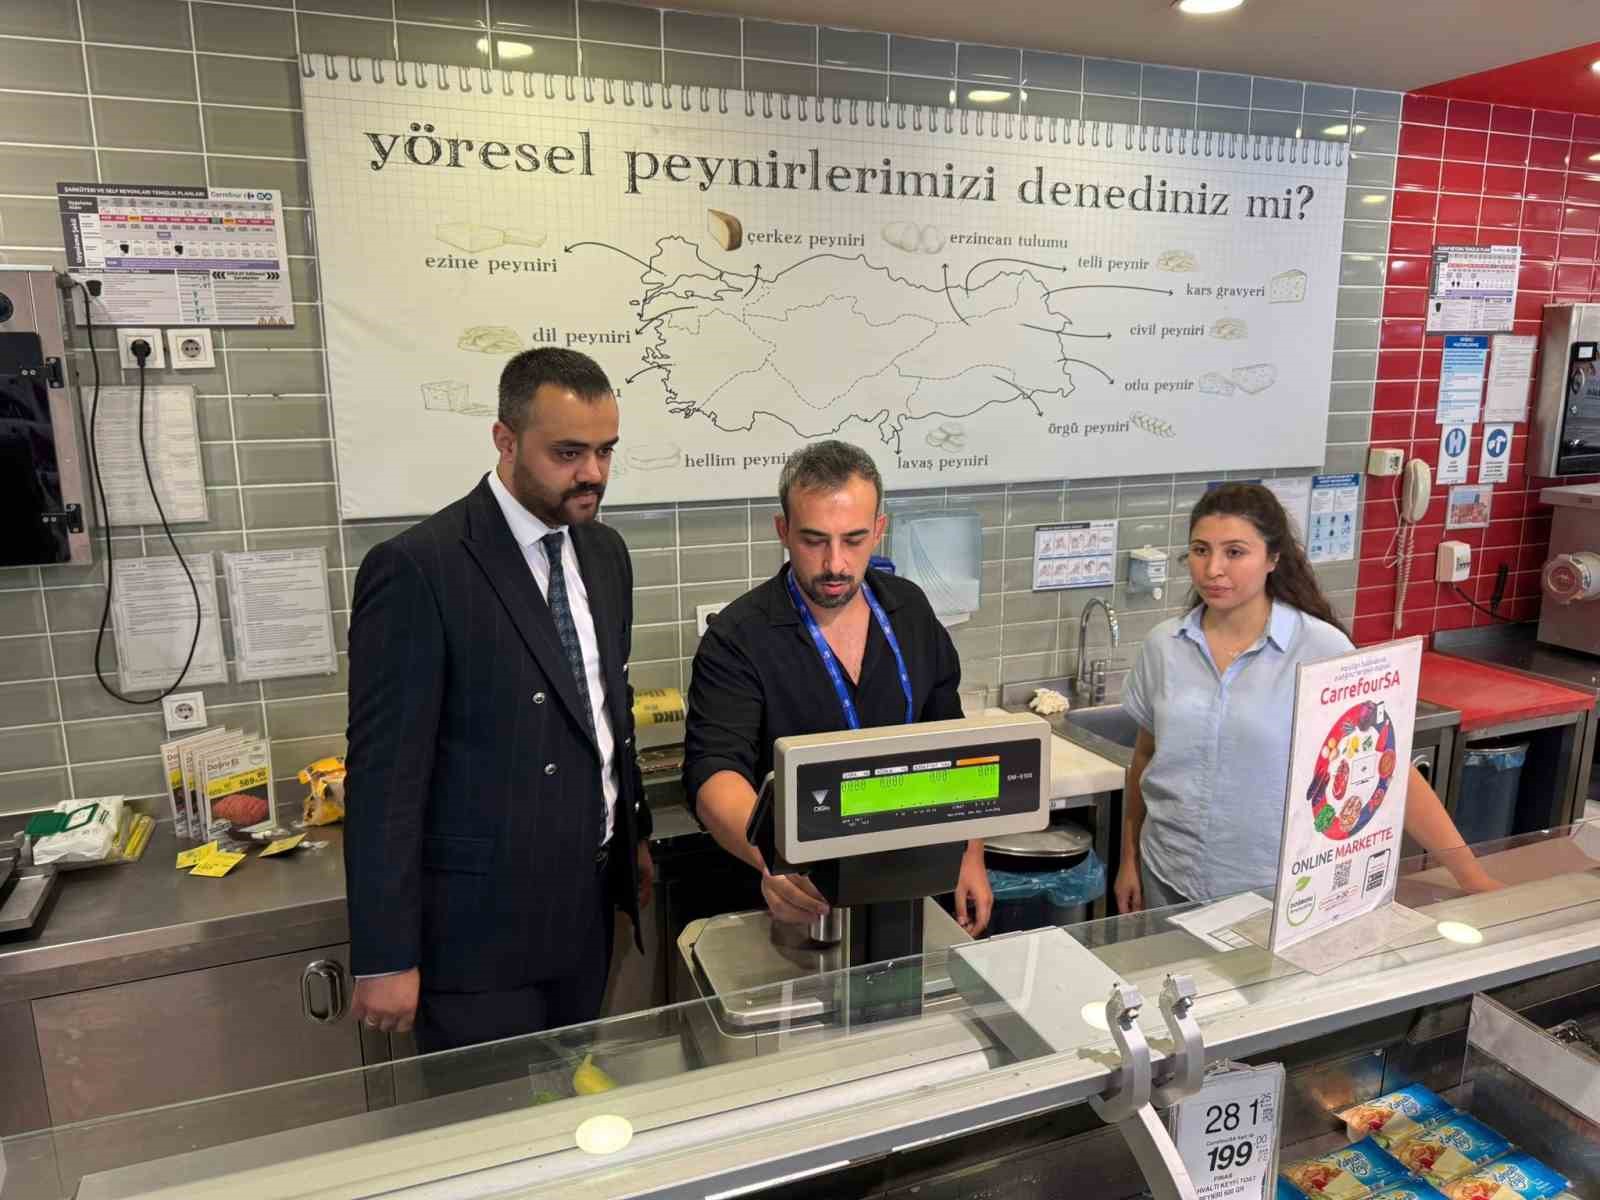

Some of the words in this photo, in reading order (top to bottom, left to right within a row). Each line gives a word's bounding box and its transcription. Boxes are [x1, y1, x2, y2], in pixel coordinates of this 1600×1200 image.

[363, 122, 595, 176] yöresel
[624, 148, 998, 201] peynirlerimizi
[1017, 166, 1230, 216] denediniz
[1246, 184, 1315, 219] mi?
[747, 229, 801, 247] çerkez
[810, 230, 865, 249] peyniri
[950, 229, 1012, 247] erzincan
[1018, 234, 1068, 249] tulumu
[425, 252, 479, 269] ezine
[488, 254, 558, 274] peyniri
[1078, 255, 1103, 269] telli
[1107, 257, 1150, 272] peynir
[1186, 281, 1213, 296] kars
[1216, 283, 1266, 299] gravyeri
[532, 327, 557, 343] dil
[565, 329, 632, 346] peyniri
[1129, 323, 1156, 337] civil
[1160, 324, 1205, 338] peyniri
[1124, 378, 1149, 391] otlu
[1154, 378, 1195, 394] peynir
[1047, 419, 1079, 437] örgü
[1083, 420, 1130, 436] peyniri
[685, 453, 736, 468] hellim
[743, 452, 792, 470] peyni
[897, 456, 933, 470] lavaş
[938, 453, 989, 471] peyniri
[1320, 670, 1401, 705] CarrefourSA
[1291, 849, 1334, 876] ONLINE
[1207, 1141, 1253, 1172] 199
